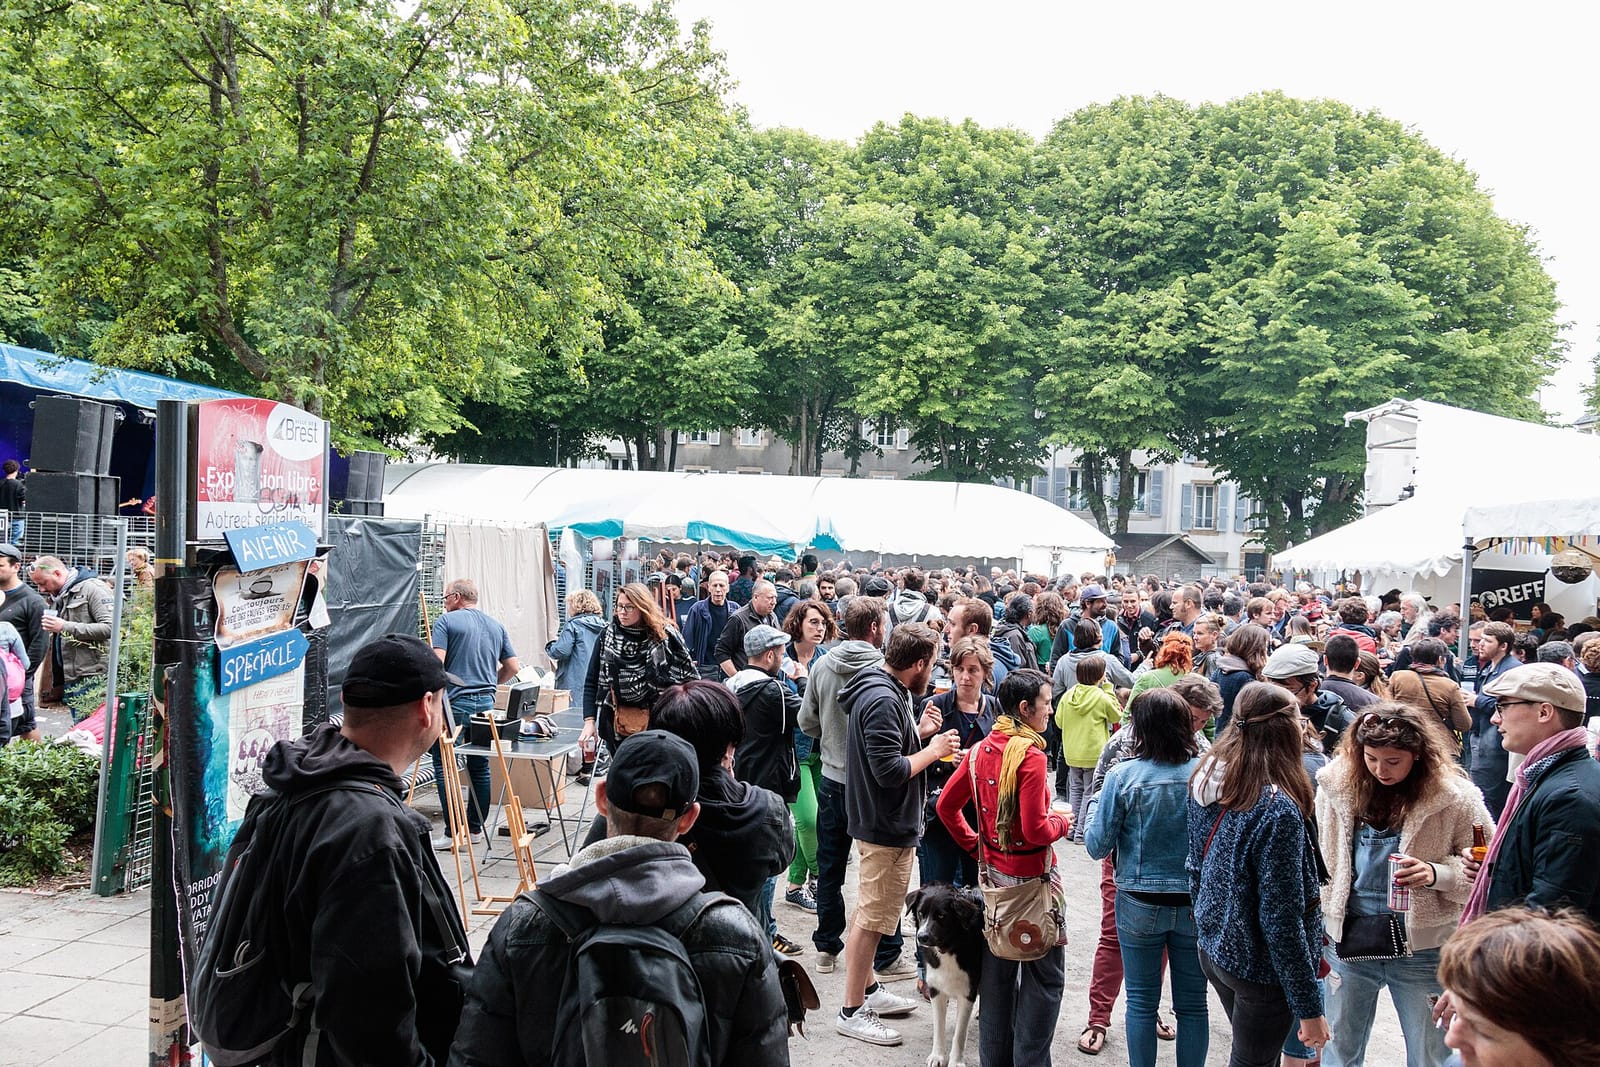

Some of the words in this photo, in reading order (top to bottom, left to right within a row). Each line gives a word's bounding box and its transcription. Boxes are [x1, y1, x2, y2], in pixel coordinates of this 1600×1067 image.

[286, 418, 318, 443] Brest
[288, 471, 317, 491] libre
[241, 529, 306, 562] AVENIR
[193, 608, 209, 626] LA
[224, 639, 296, 687] SPECTACLE
